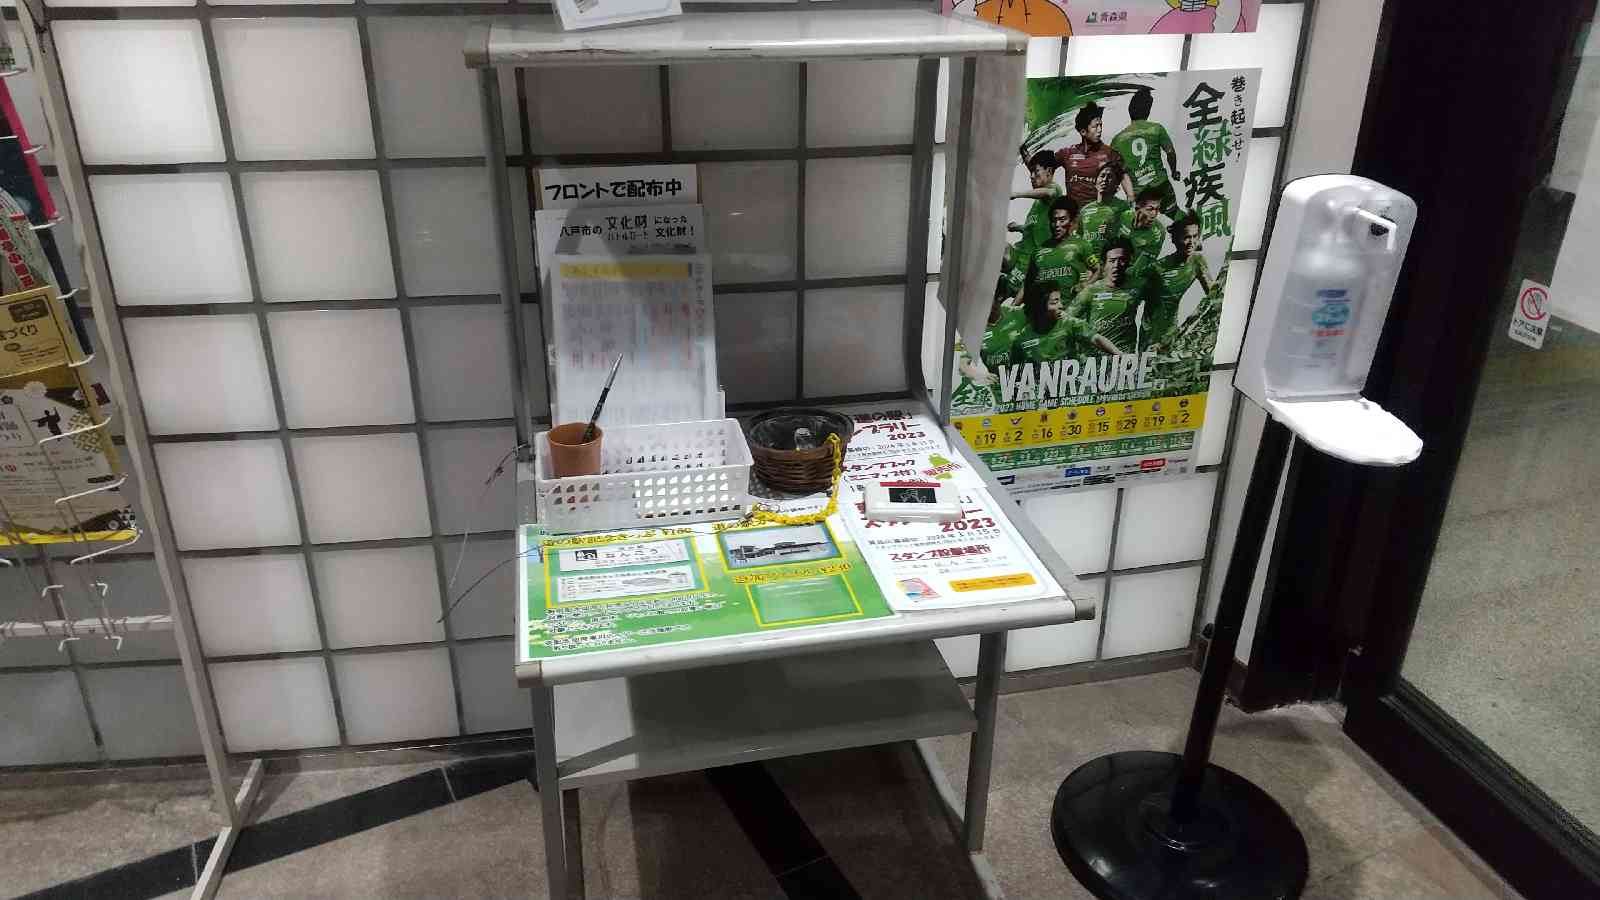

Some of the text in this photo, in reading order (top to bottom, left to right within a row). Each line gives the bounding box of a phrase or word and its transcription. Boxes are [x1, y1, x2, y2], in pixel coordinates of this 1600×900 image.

[1131, 137, 1148, 168] 9
[544, 178, 682, 201] フロントで配布中
[605, 214, 648, 231] 文化財
[999, 352, 1157, 403] VANRAURE
[887, 431, 926, 442] 2023
[938, 517, 996, 533] 2023
